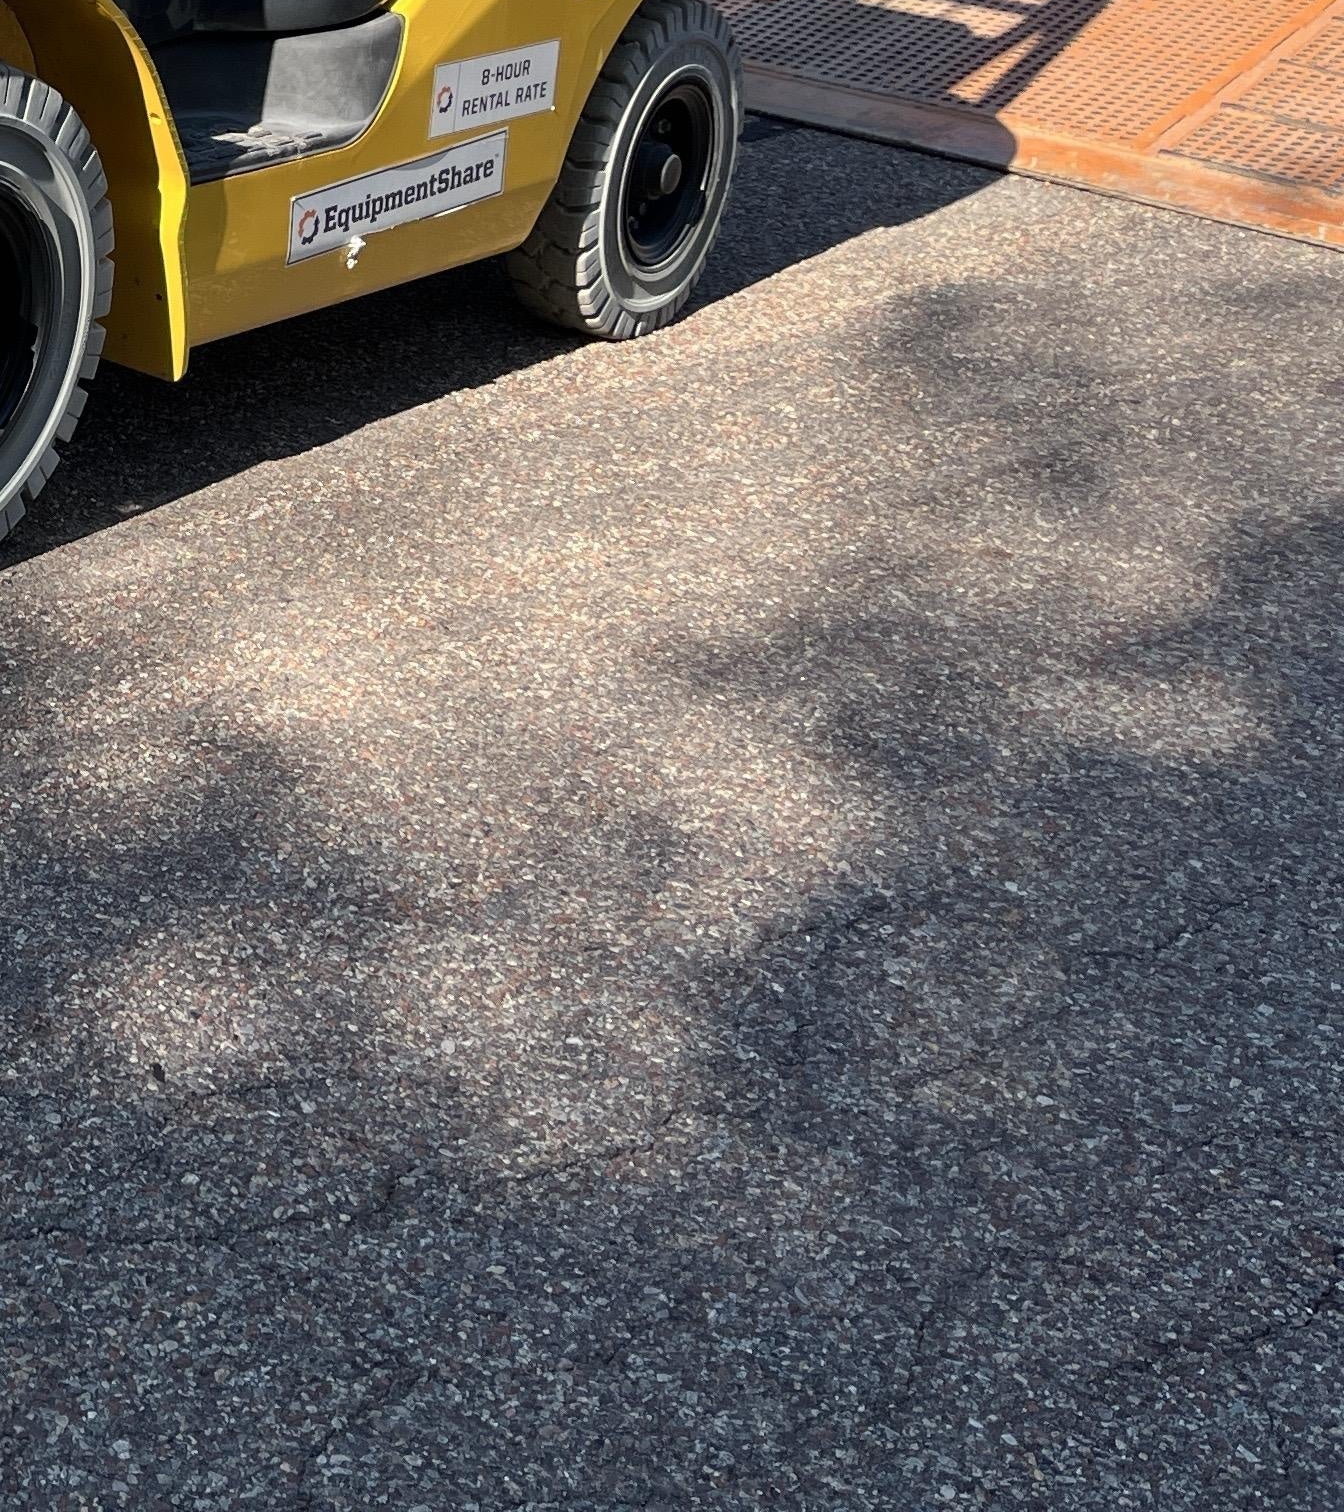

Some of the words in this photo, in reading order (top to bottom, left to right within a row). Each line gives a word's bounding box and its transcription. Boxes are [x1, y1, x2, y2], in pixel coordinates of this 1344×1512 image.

[481, 59, 531, 85] 8-HOUR
[462, 90, 511, 117] RENTAL
[515, 81, 548, 104] RATE
[323, 158, 495, 233] EquipmentShare
